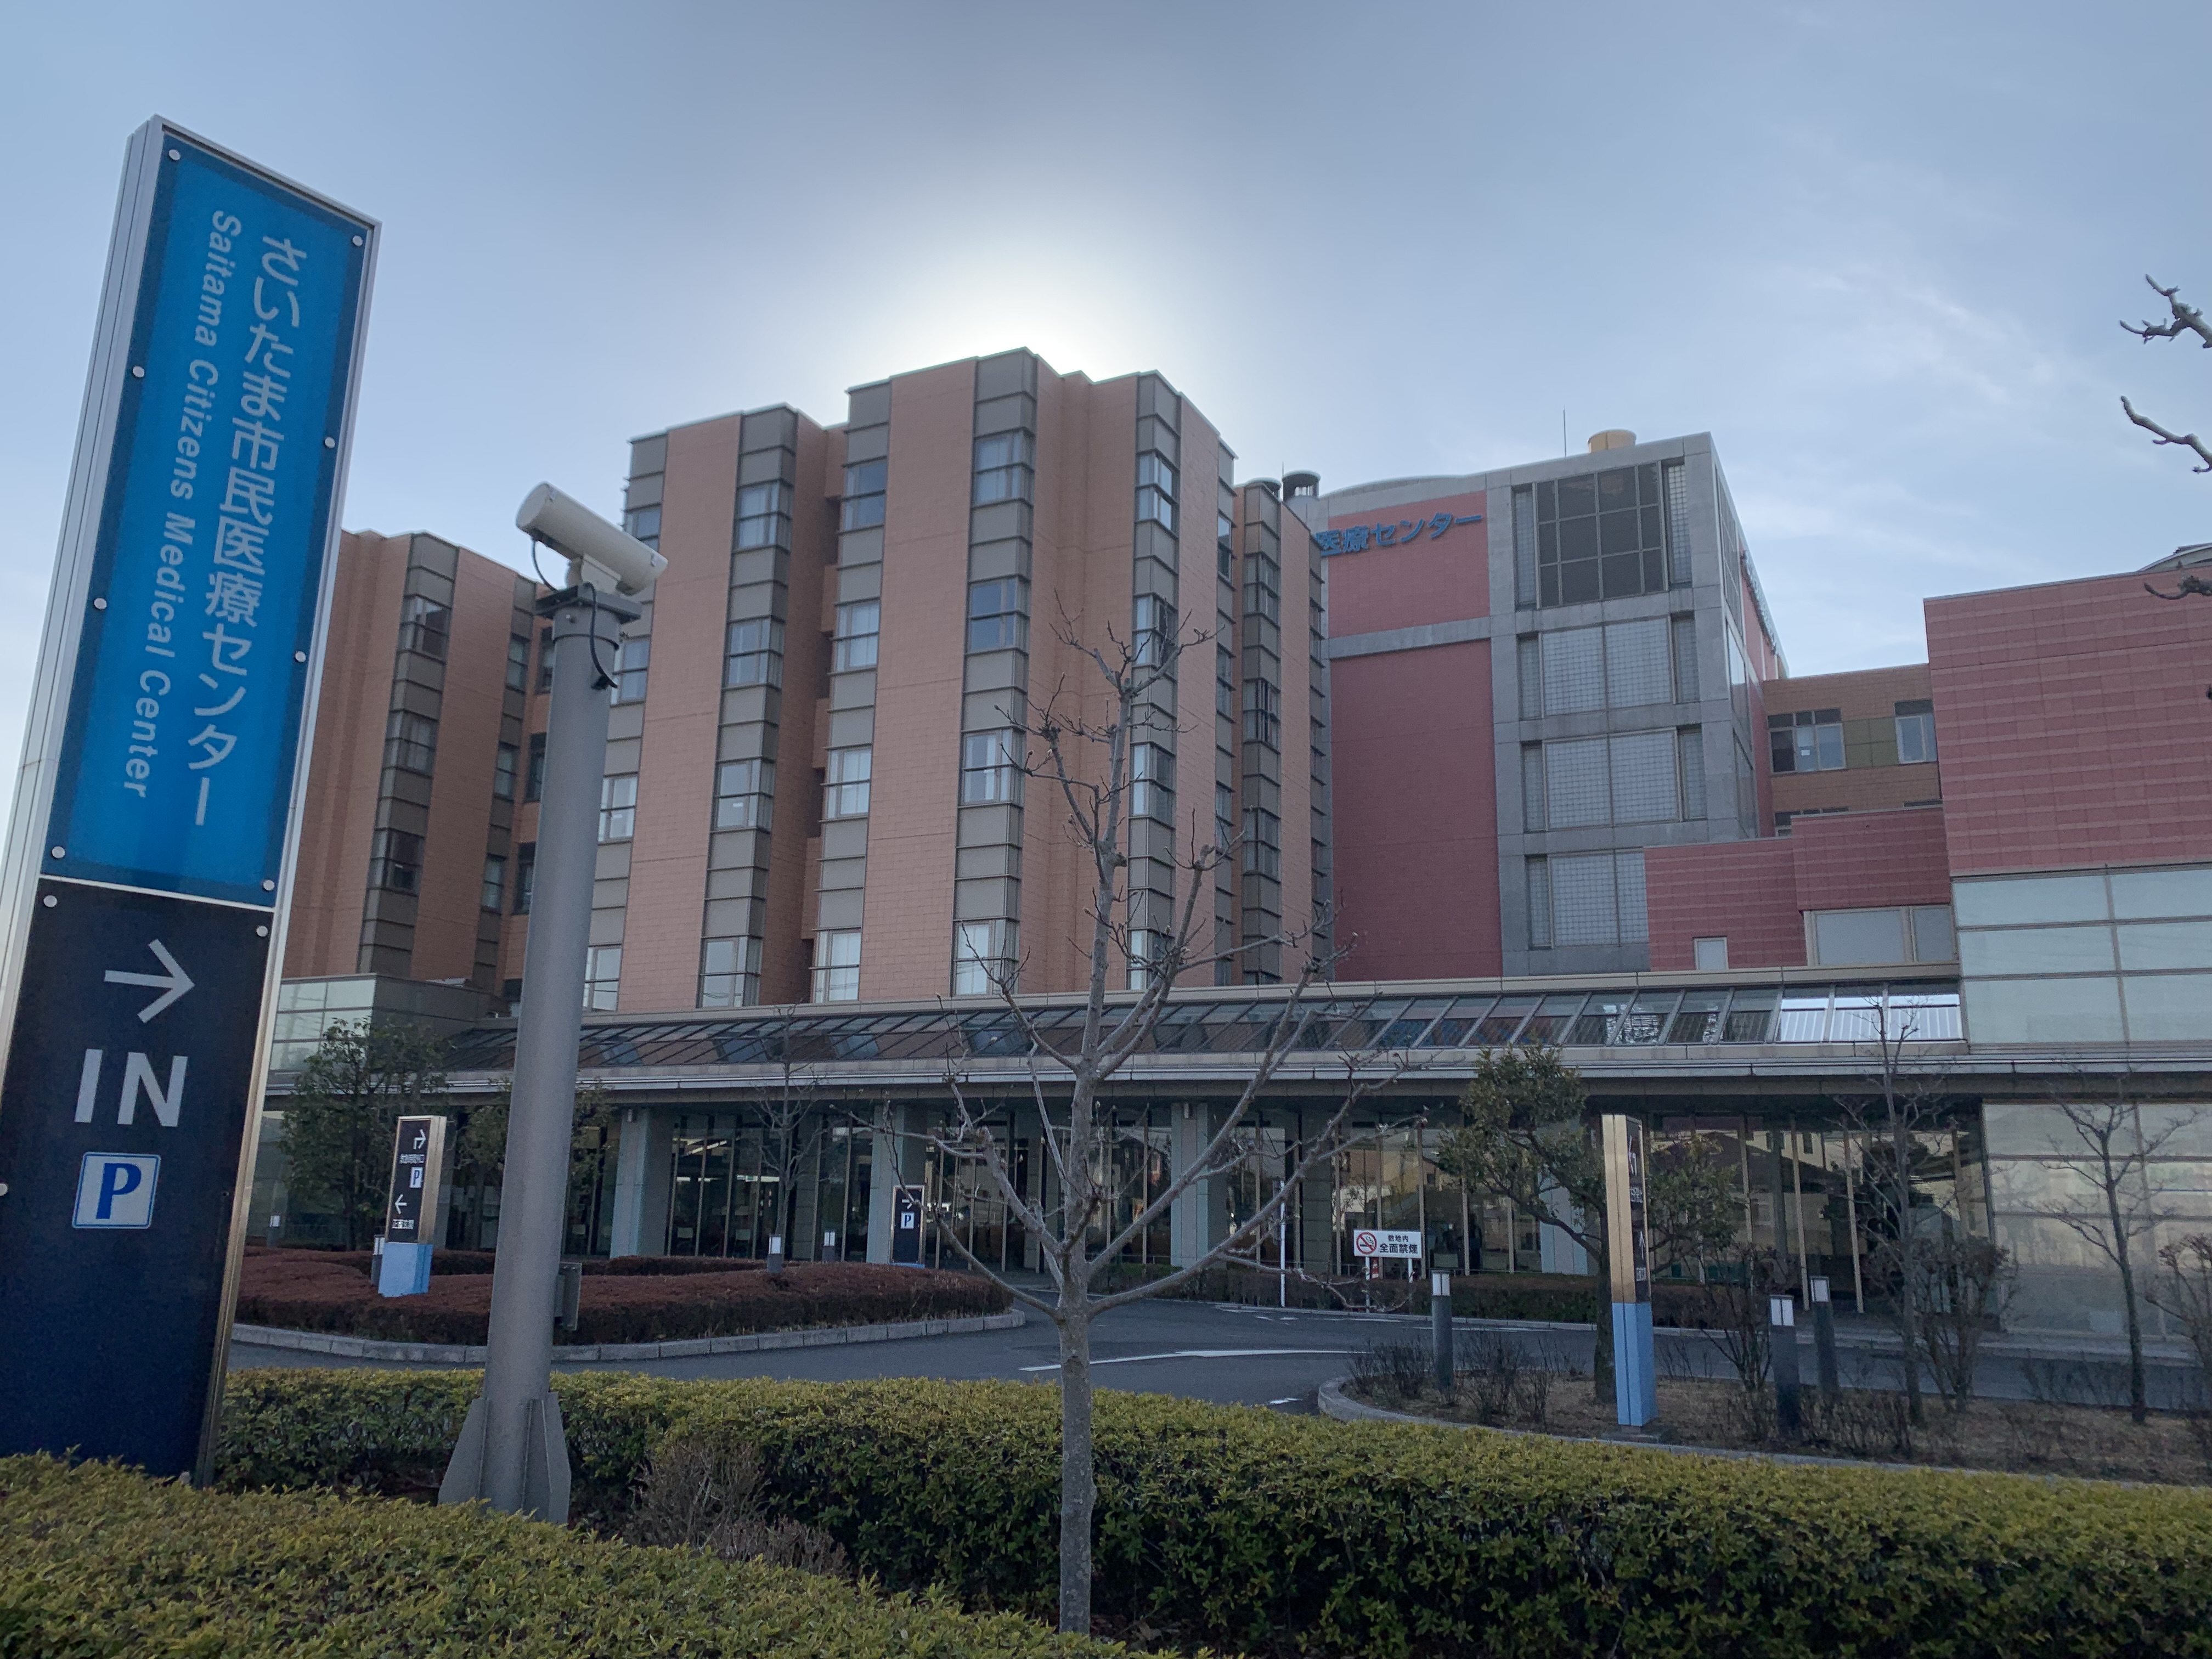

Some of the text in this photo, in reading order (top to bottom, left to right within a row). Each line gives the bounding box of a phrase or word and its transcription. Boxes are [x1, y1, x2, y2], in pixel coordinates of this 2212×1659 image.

[124, 210, 241, 798] Saitama Citizens Medical Center
[188, 234, 307, 826] さいたま市民医療センター
[1316, 512, 1482, 558] 医療センター
[74, 1048, 188, 1127] IN
[95, 1162, 142, 1220] P
[1379, 1243, 1418, 1254] 全面禁煙
[1387, 1234, 1409, 1243] 敷地内
